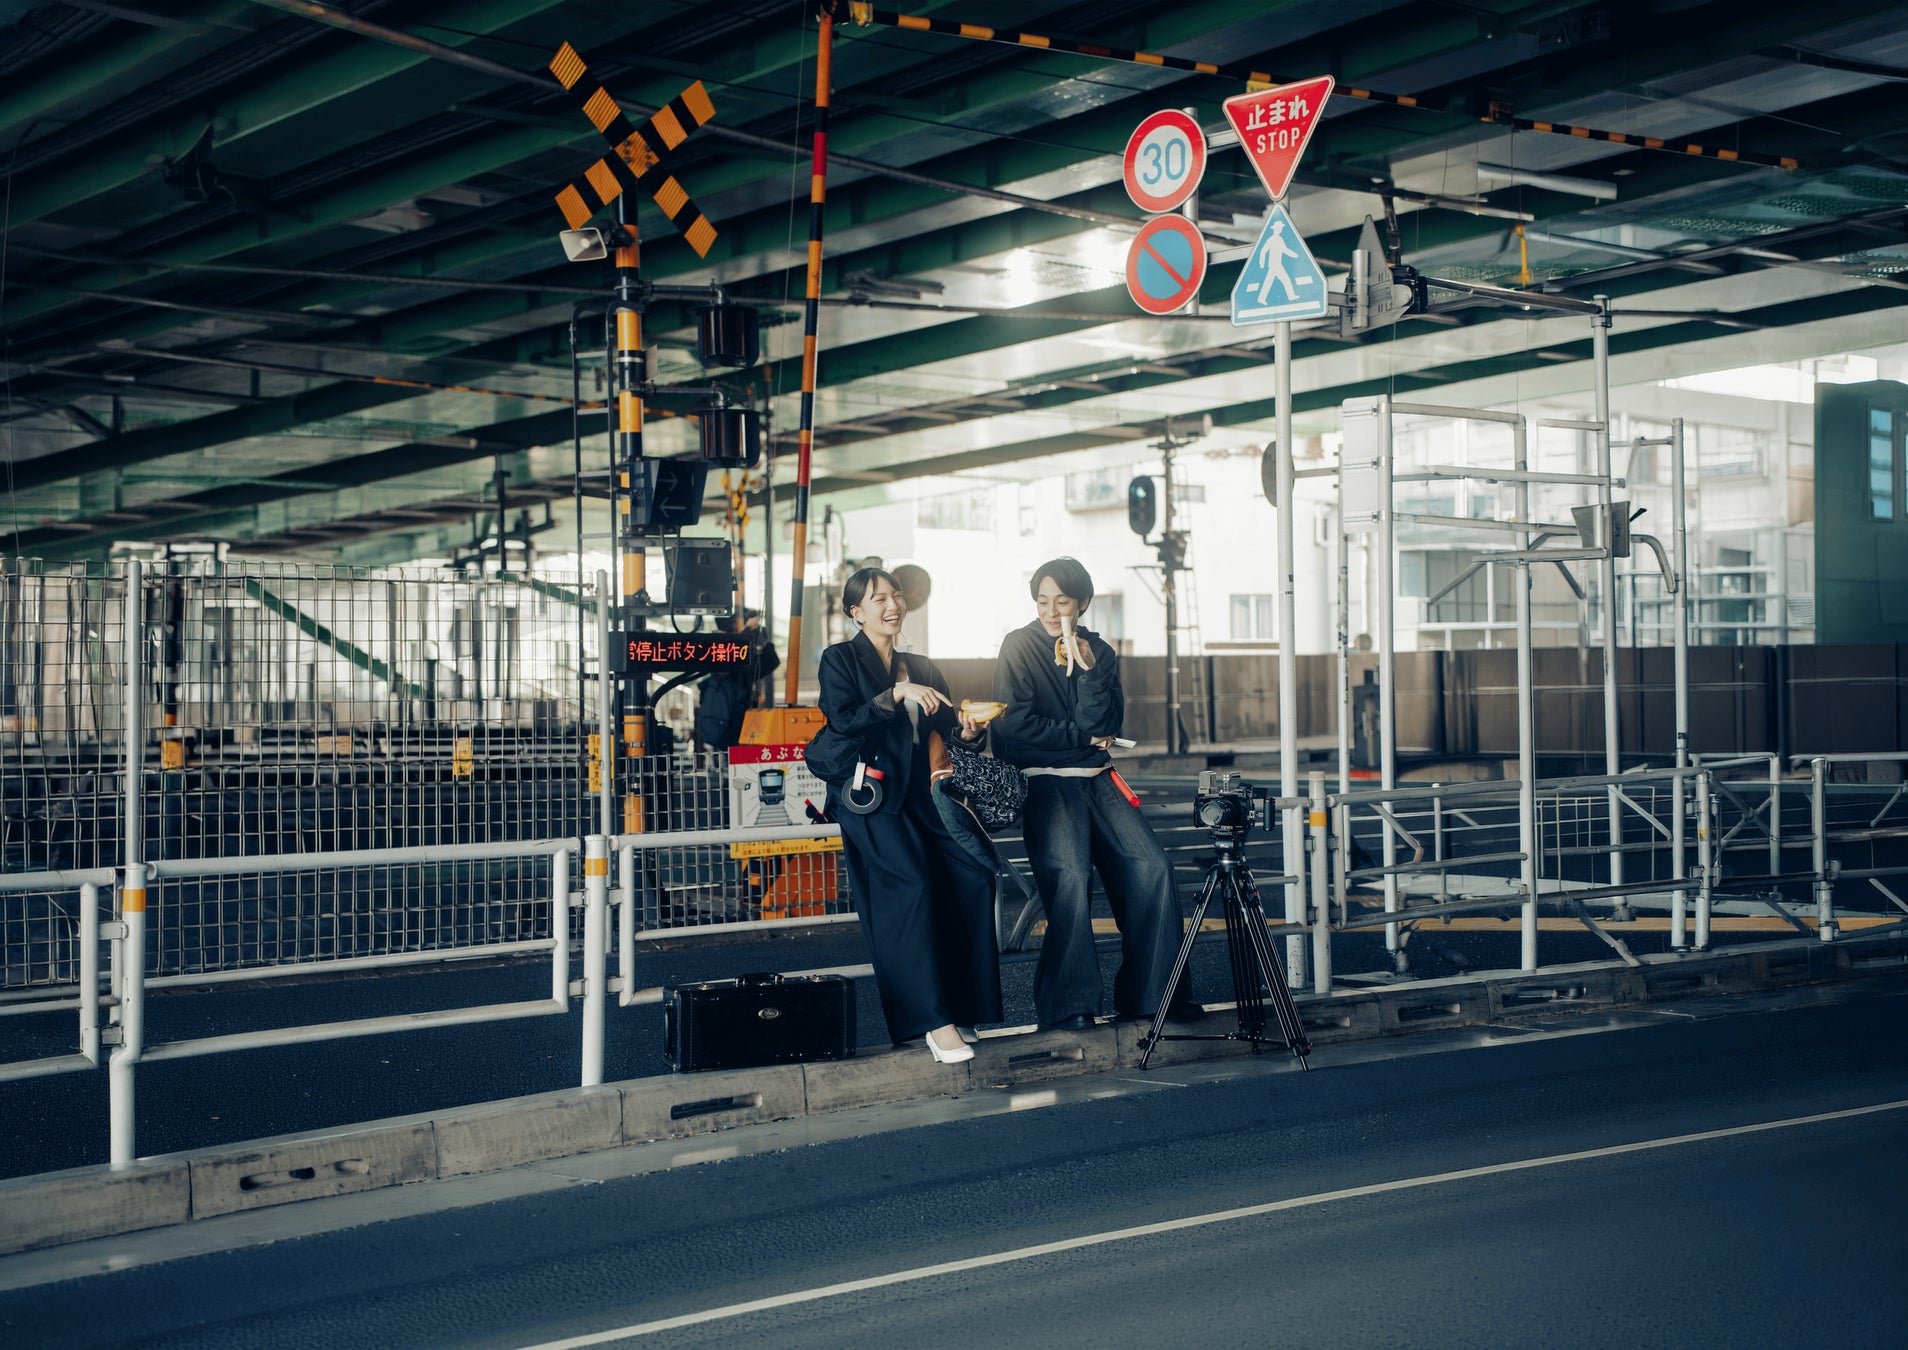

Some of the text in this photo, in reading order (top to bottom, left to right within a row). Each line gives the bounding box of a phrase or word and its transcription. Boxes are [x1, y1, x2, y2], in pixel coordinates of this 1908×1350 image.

[1245, 95, 1310, 131] 止まれ
[1256, 129, 1301, 154] STOP
[1142, 137, 1186, 185] 30
[760, 745, 804, 761] あぶな
